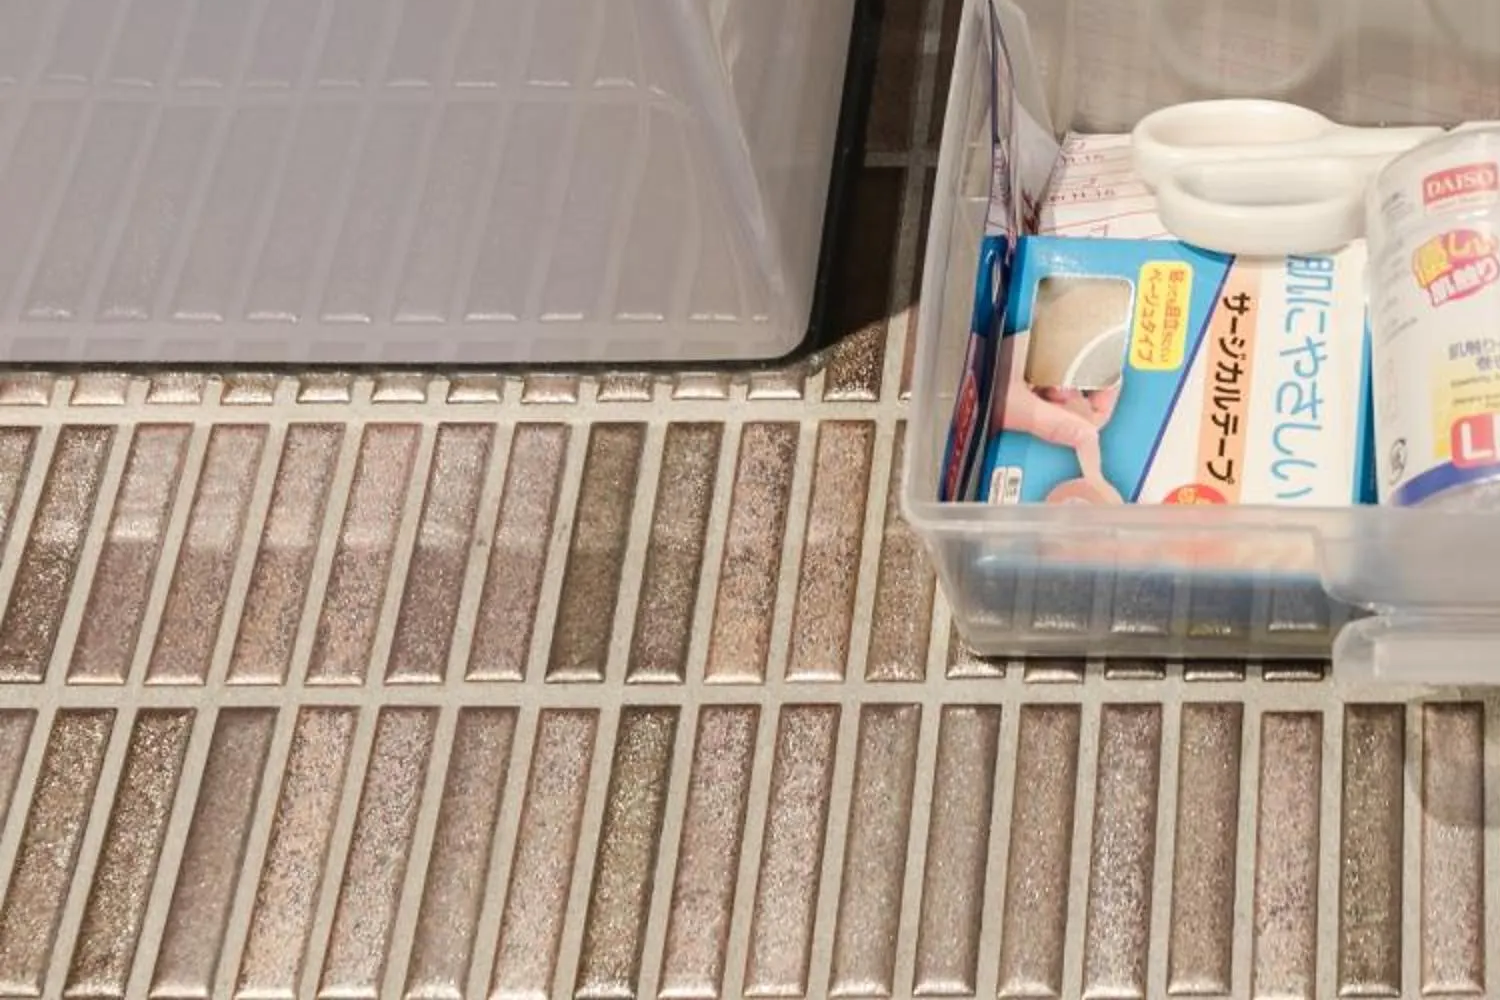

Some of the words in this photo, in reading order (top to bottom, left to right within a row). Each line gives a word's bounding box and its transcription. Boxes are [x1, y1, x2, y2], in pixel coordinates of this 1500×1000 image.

[1426, 169, 1494, 198] DAISO
[1206, 292, 1251, 485] サージカルテープ
[1271, 255, 1336, 499] 肌にやさしい
[1460, 421, 1493, 461] L
